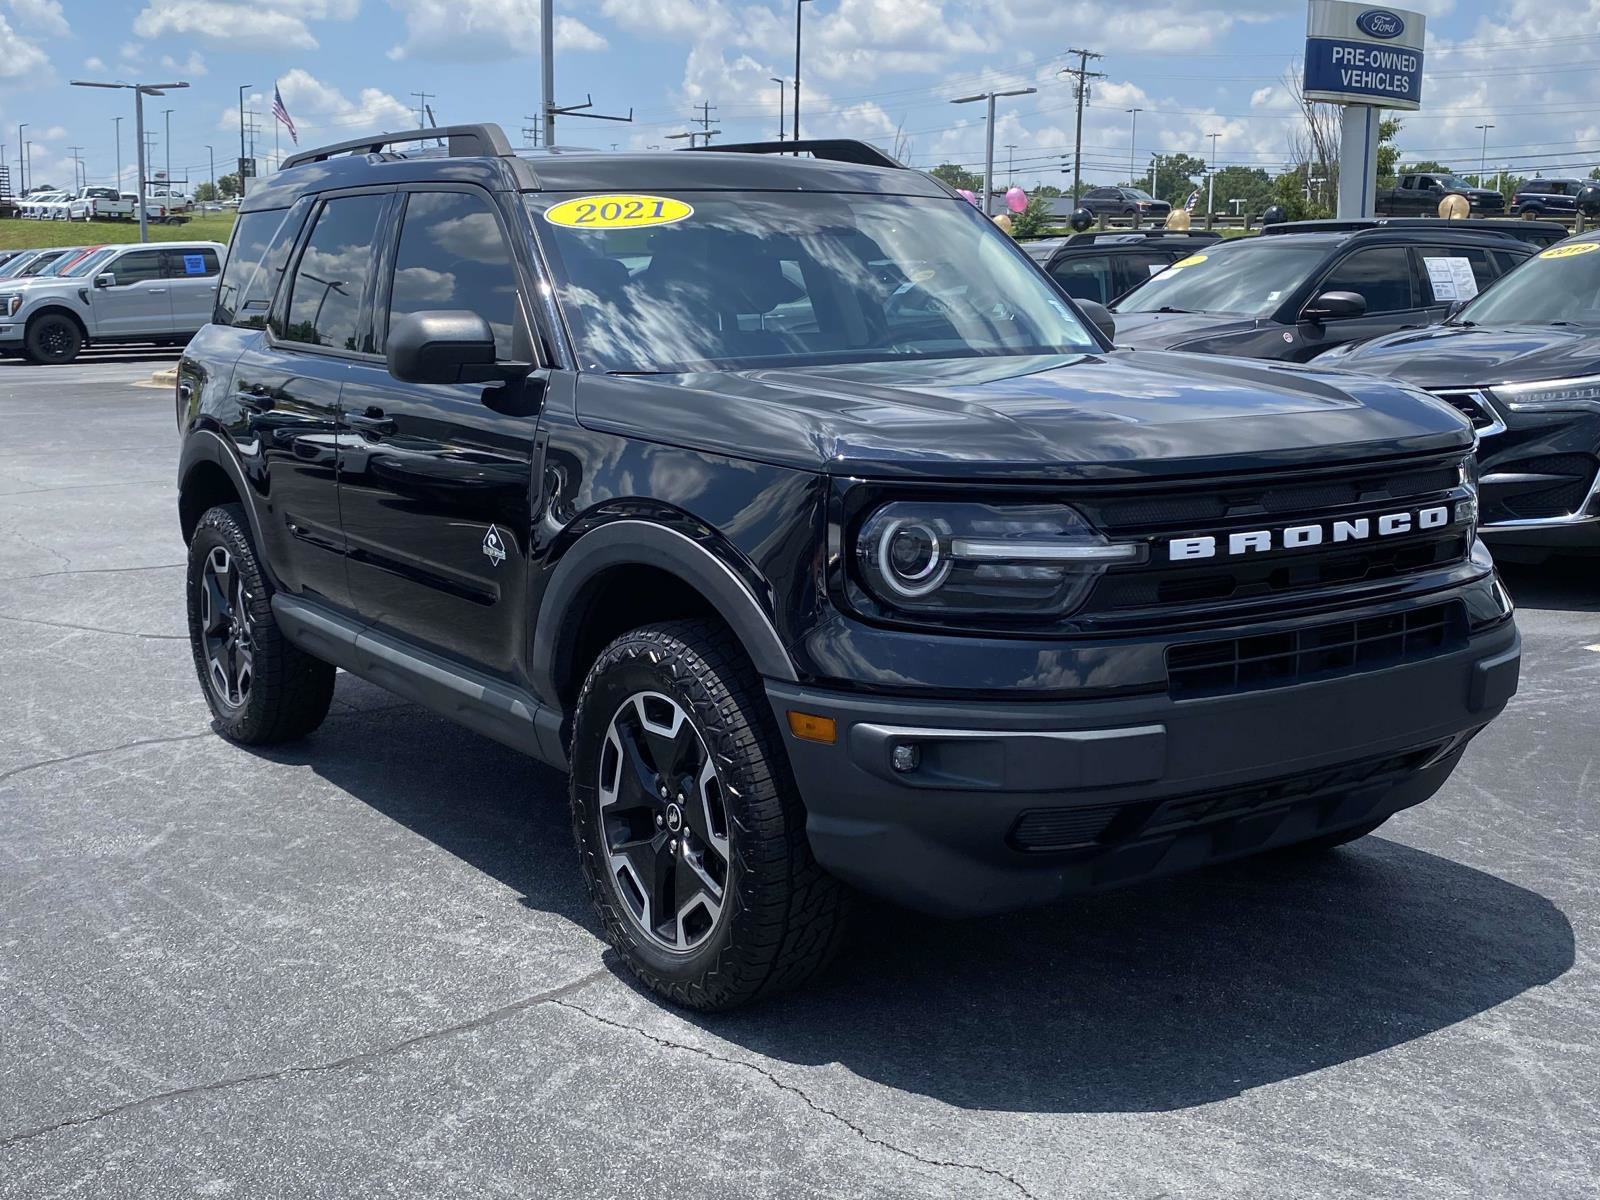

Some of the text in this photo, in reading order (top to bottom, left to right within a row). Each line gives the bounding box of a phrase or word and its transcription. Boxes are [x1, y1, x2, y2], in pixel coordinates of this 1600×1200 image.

[1371, 16, 1396, 33] Ford
[1332, 47, 1417, 72] PRE-OWNED
[1341, 69, 1409, 92] VEHICLES
[575, 201, 665, 223] 2021
[1169, 506, 1448, 561] BRONCO
